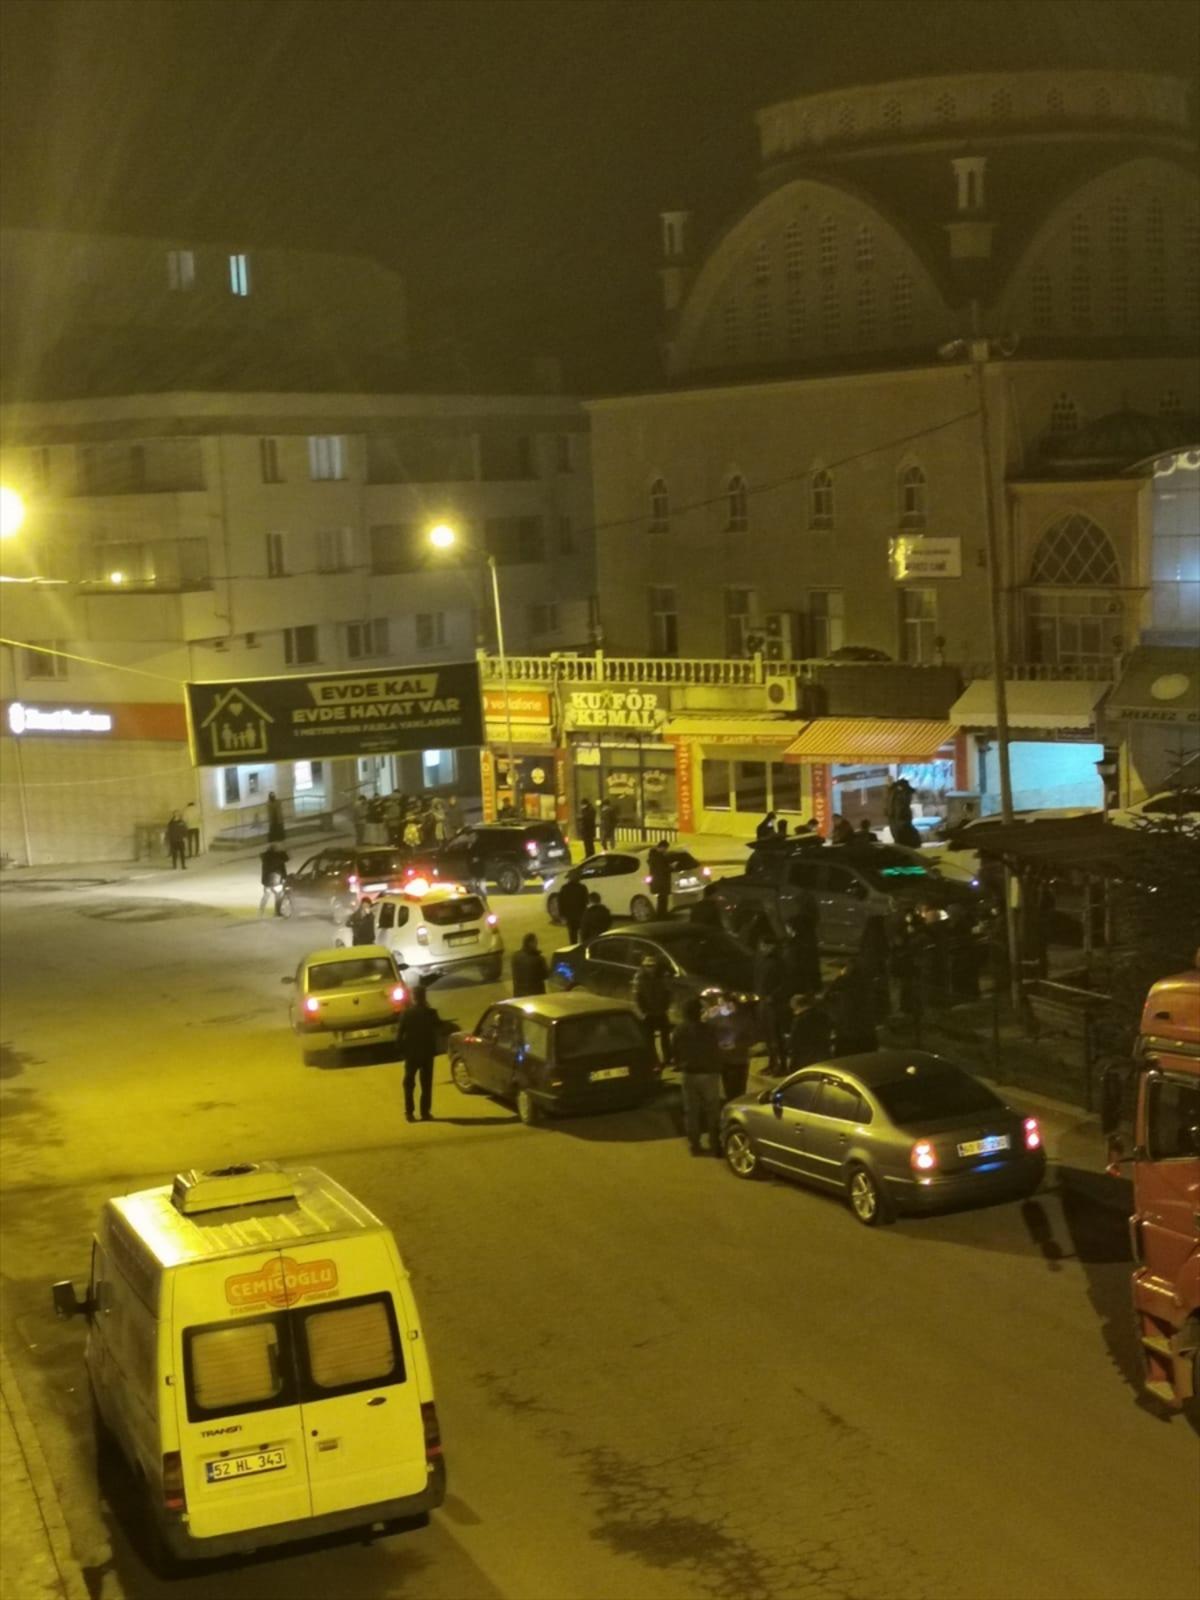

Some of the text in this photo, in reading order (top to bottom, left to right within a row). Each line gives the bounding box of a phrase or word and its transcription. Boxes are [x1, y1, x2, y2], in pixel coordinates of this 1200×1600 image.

[321, 680, 428, 700] EVDE KAL
[292, 698, 461, 723] EVDE HAYAT VAR
[576, 709, 655, 727] KEMAL
[1120, 709, 1177, 721] MERKEZ
[214, 1452, 282, 1476] 52 HL 343
